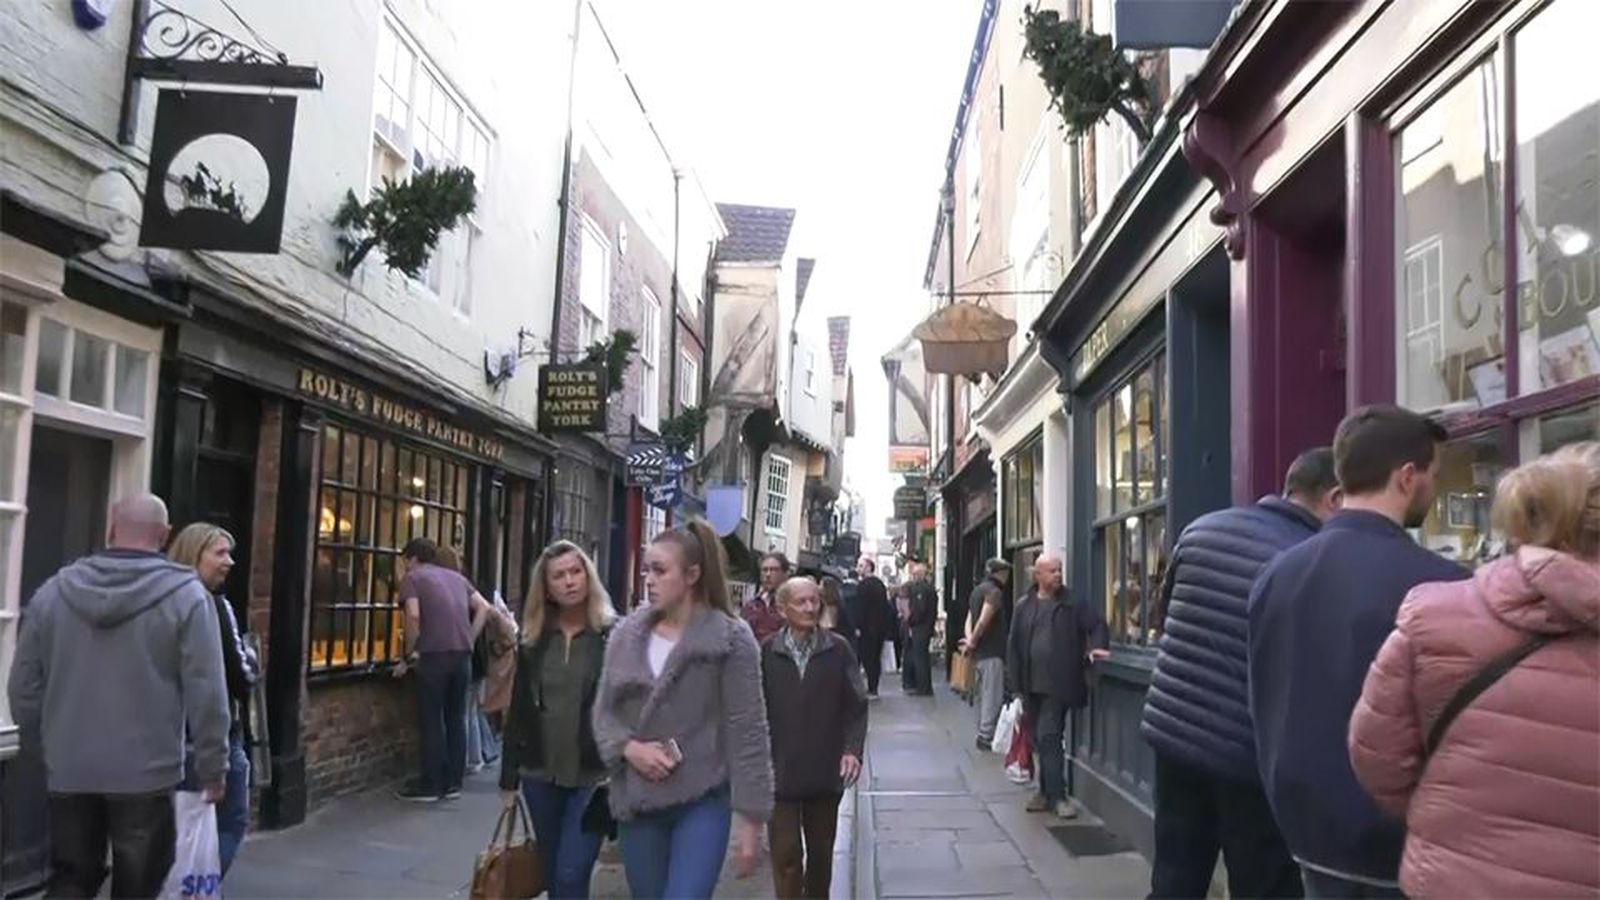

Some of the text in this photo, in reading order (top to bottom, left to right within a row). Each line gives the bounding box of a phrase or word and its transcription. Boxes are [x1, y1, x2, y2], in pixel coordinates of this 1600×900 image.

[548, 370, 597, 382] ROLY'S
[547, 385, 597, 397] FUDGE
[300, 369, 366, 410] ROLY'S
[372, 395, 423, 431] FUDGE
[427, 416, 474, 449] PANTRY
[543, 400, 600, 412] PANTRY
[552, 414, 592, 426] YORK
